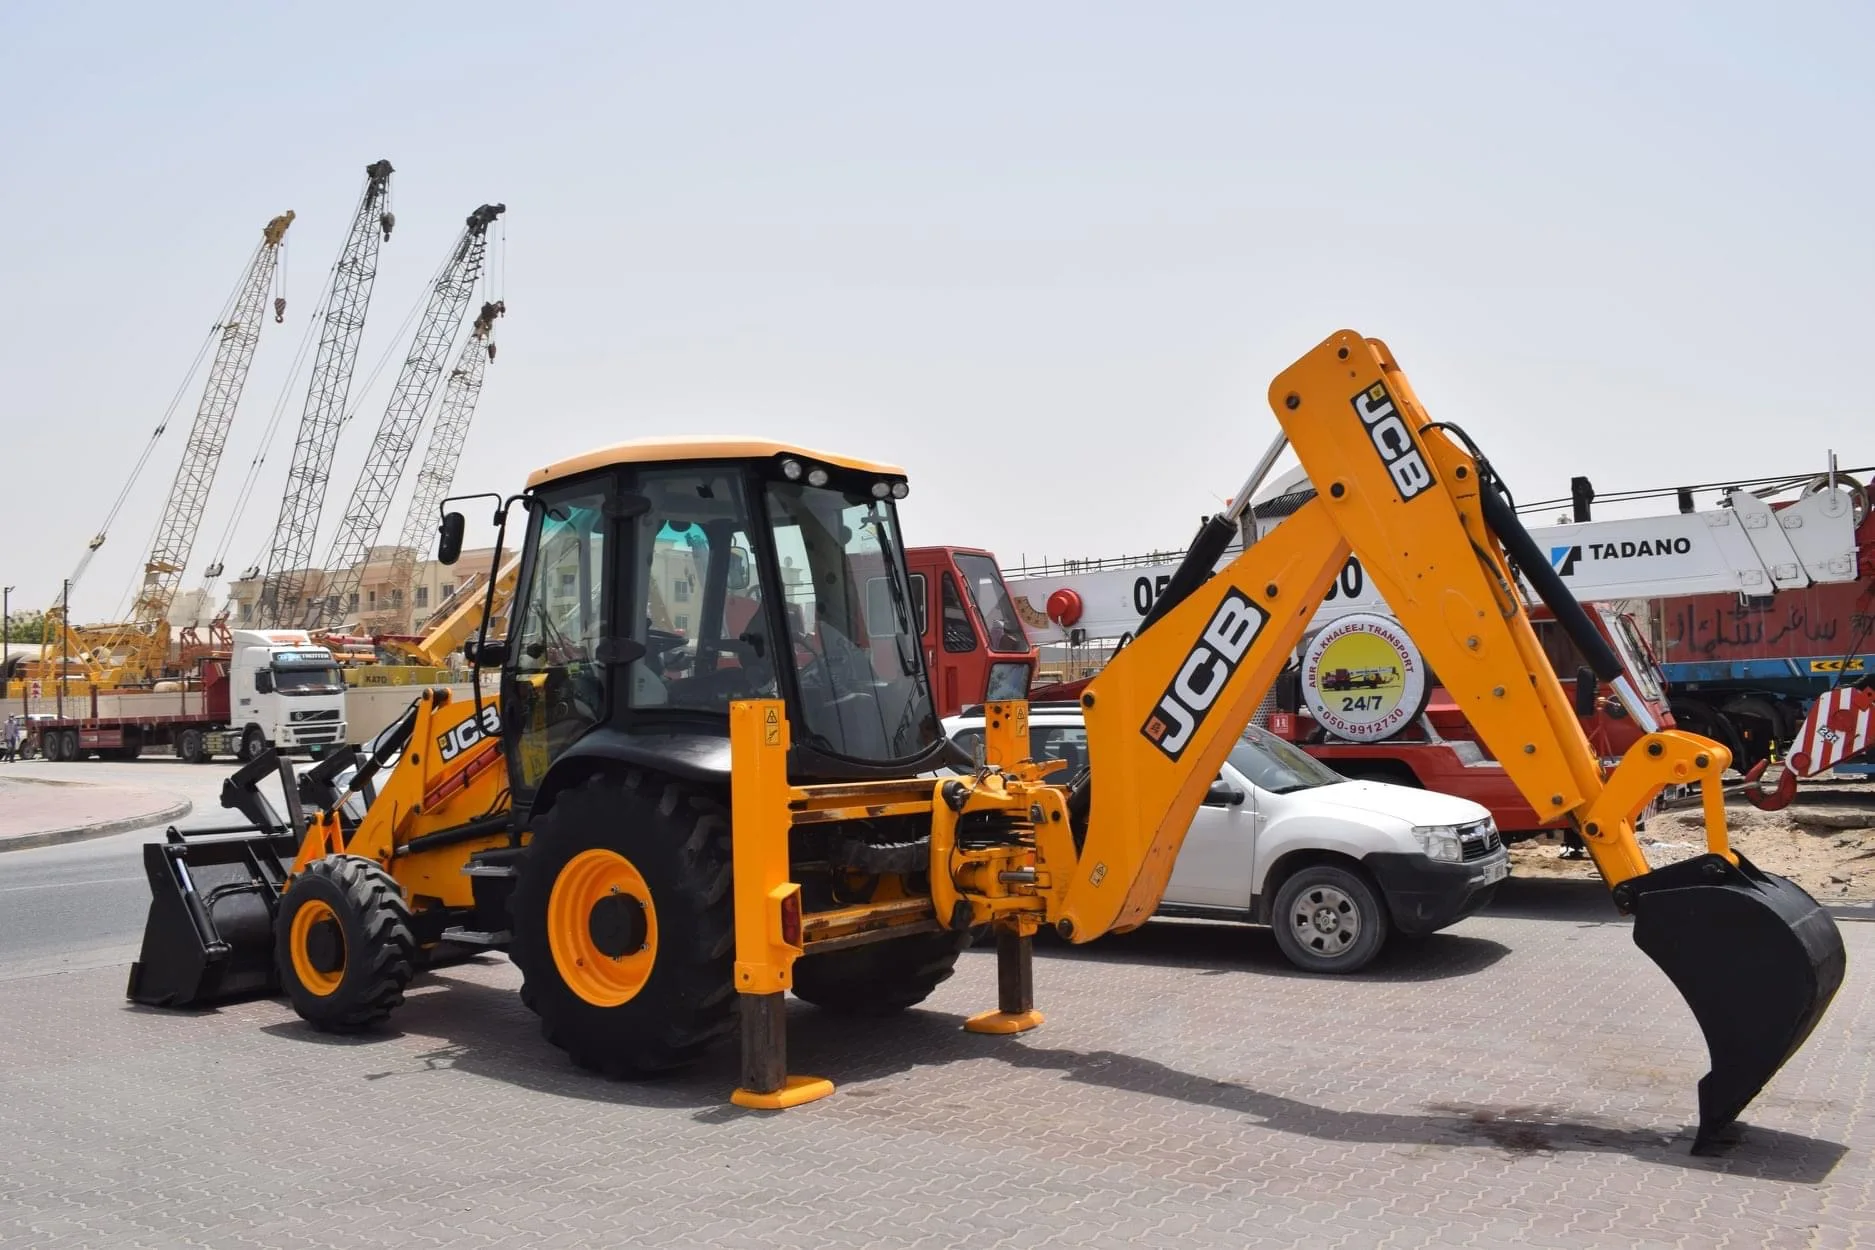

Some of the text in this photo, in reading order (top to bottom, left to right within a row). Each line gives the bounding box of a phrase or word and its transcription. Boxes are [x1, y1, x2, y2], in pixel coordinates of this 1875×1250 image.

[1356, 393, 1430, 497] JCB
[1589, 537, 1691, 560] TADANO
[1312, 651, 1322, 664] AL
[1320, 623, 1364, 649] KHALEEJ
[1368, 624, 1414, 673] TRANSPORT
[365, 675, 387, 684] KATO
[1160, 596, 1262, 753] JCB
[1322, 708, 1404, 734] 050-9912730
[1342, 695, 1383, 712] 24/7
[441, 706, 500, 760] JCB
